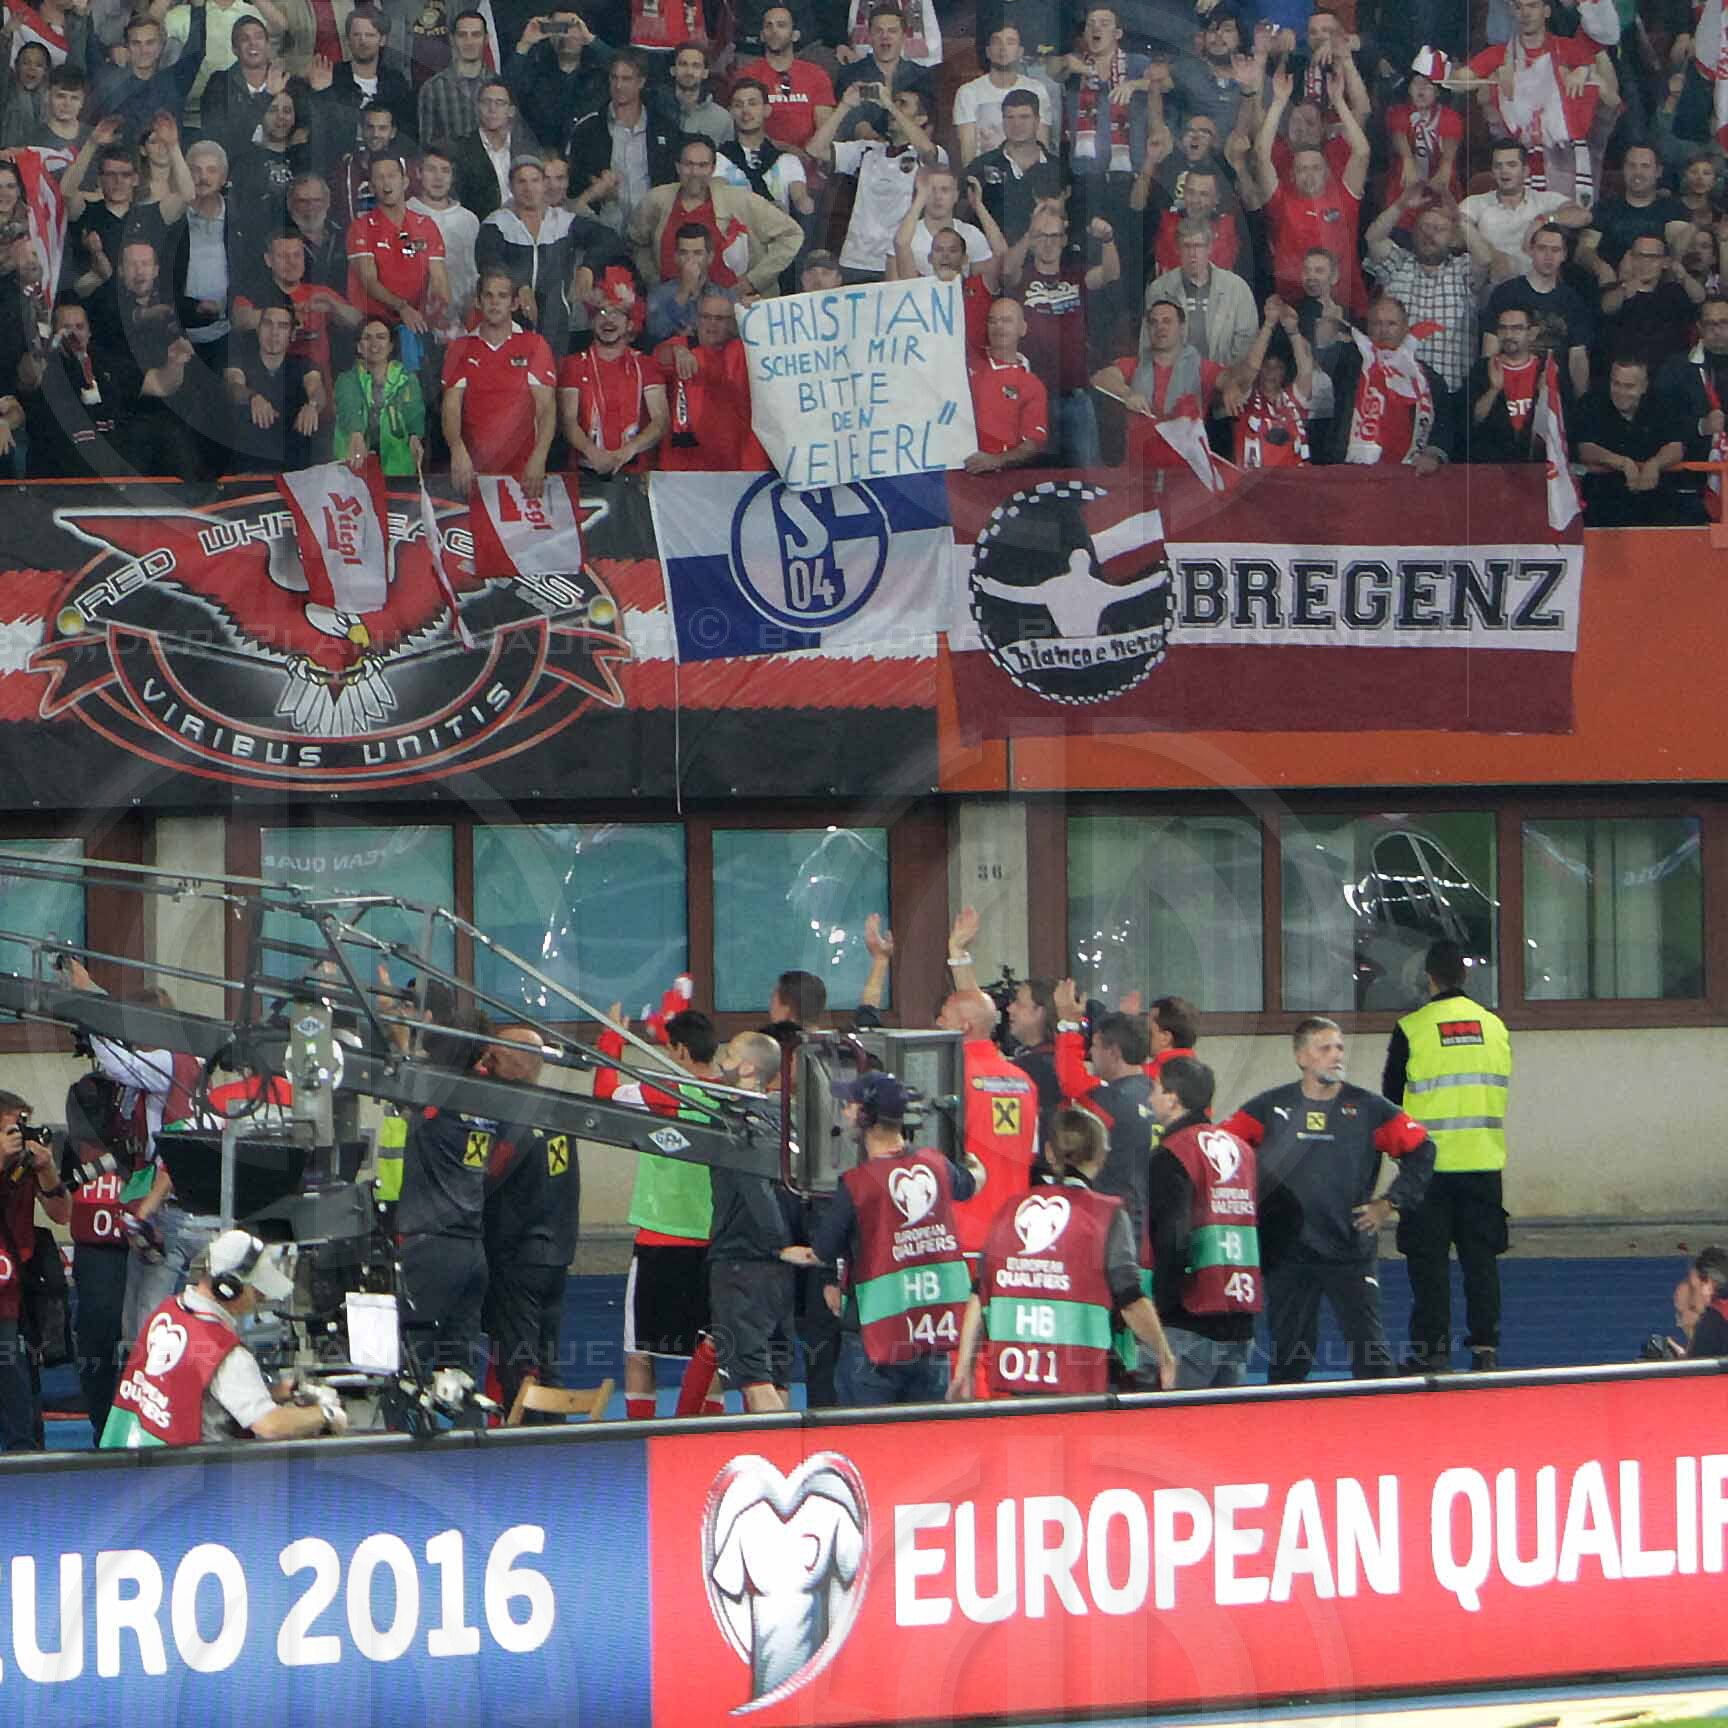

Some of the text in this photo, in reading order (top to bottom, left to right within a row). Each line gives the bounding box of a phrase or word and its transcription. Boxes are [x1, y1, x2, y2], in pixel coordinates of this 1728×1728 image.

[742, 284, 955, 349] CHRISTIAN
[759, 336, 925, 382] SCHENK MIR
[798, 371, 889, 414] BITTE
[831, 408, 874, 432] DEN
[77, 546, 176, 622] RED
[788, 558, 836, 612] 04
[1176, 557, 1569, 631] BREGENZ
[142, 676, 513, 769] VIRIBUS UNITIS
[904, 1269, 940, 1301] HB
[1015, 1304, 1055, 1337] HB
[999, 1347, 1059, 1384] 011
[893, 1473, 1401, 1627] EUROPEAN
[276, 1524, 557, 1674] 2016
